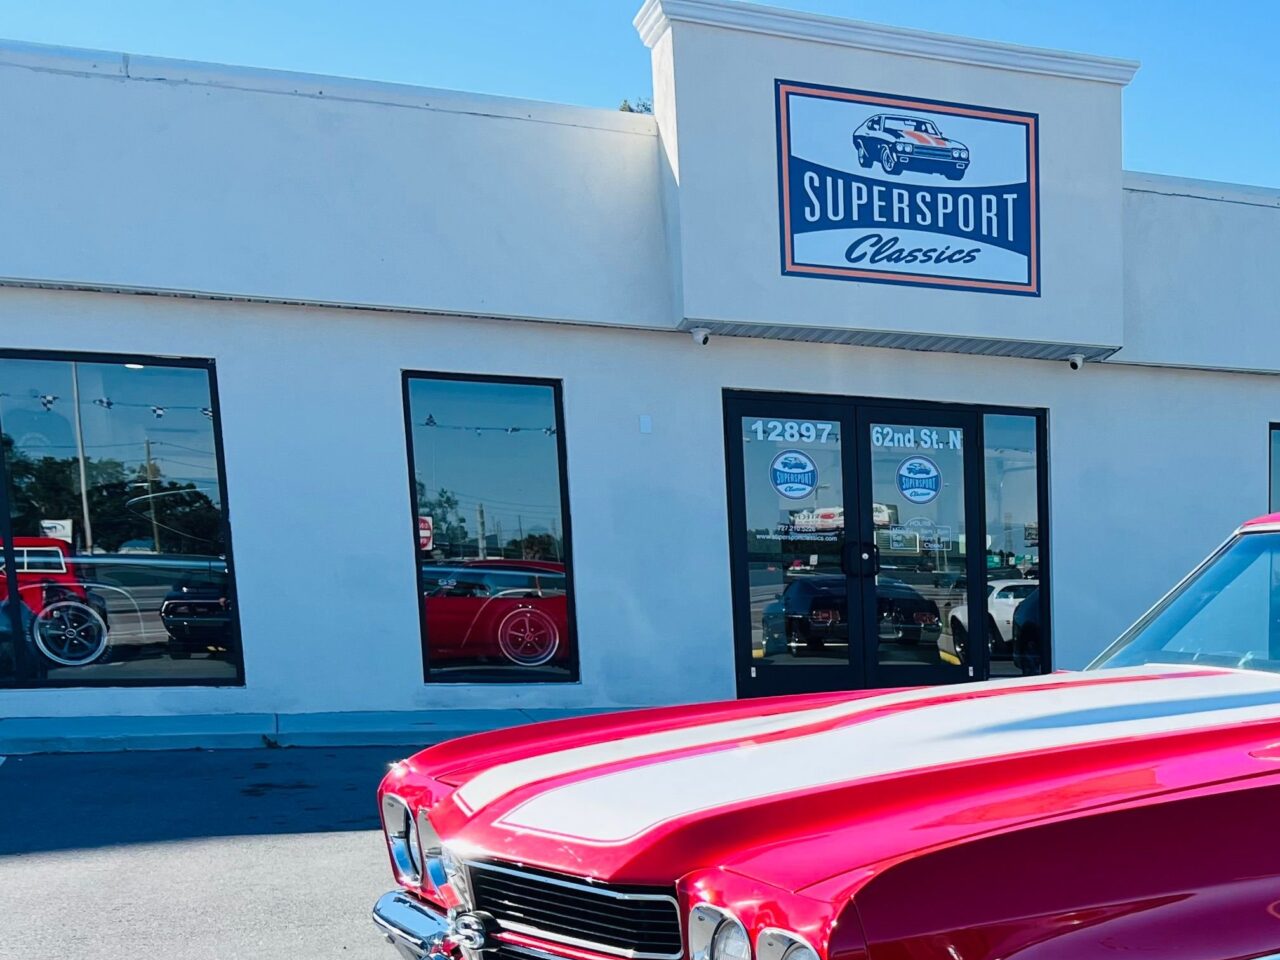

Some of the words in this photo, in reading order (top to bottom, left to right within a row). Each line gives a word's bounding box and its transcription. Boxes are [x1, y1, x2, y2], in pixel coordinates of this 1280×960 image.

[803, 170, 1018, 241] SUPERSPORT
[844, 233, 982, 264] Classics
[751, 420, 833, 444] 12897
[872, 427, 915, 448] 62nd
[920, 428, 944, 449] St.
[949, 430, 962, 450] N
[776, 471, 812, 485] SUPERSPORT
[902, 476, 936, 489] SUPERSPORT
